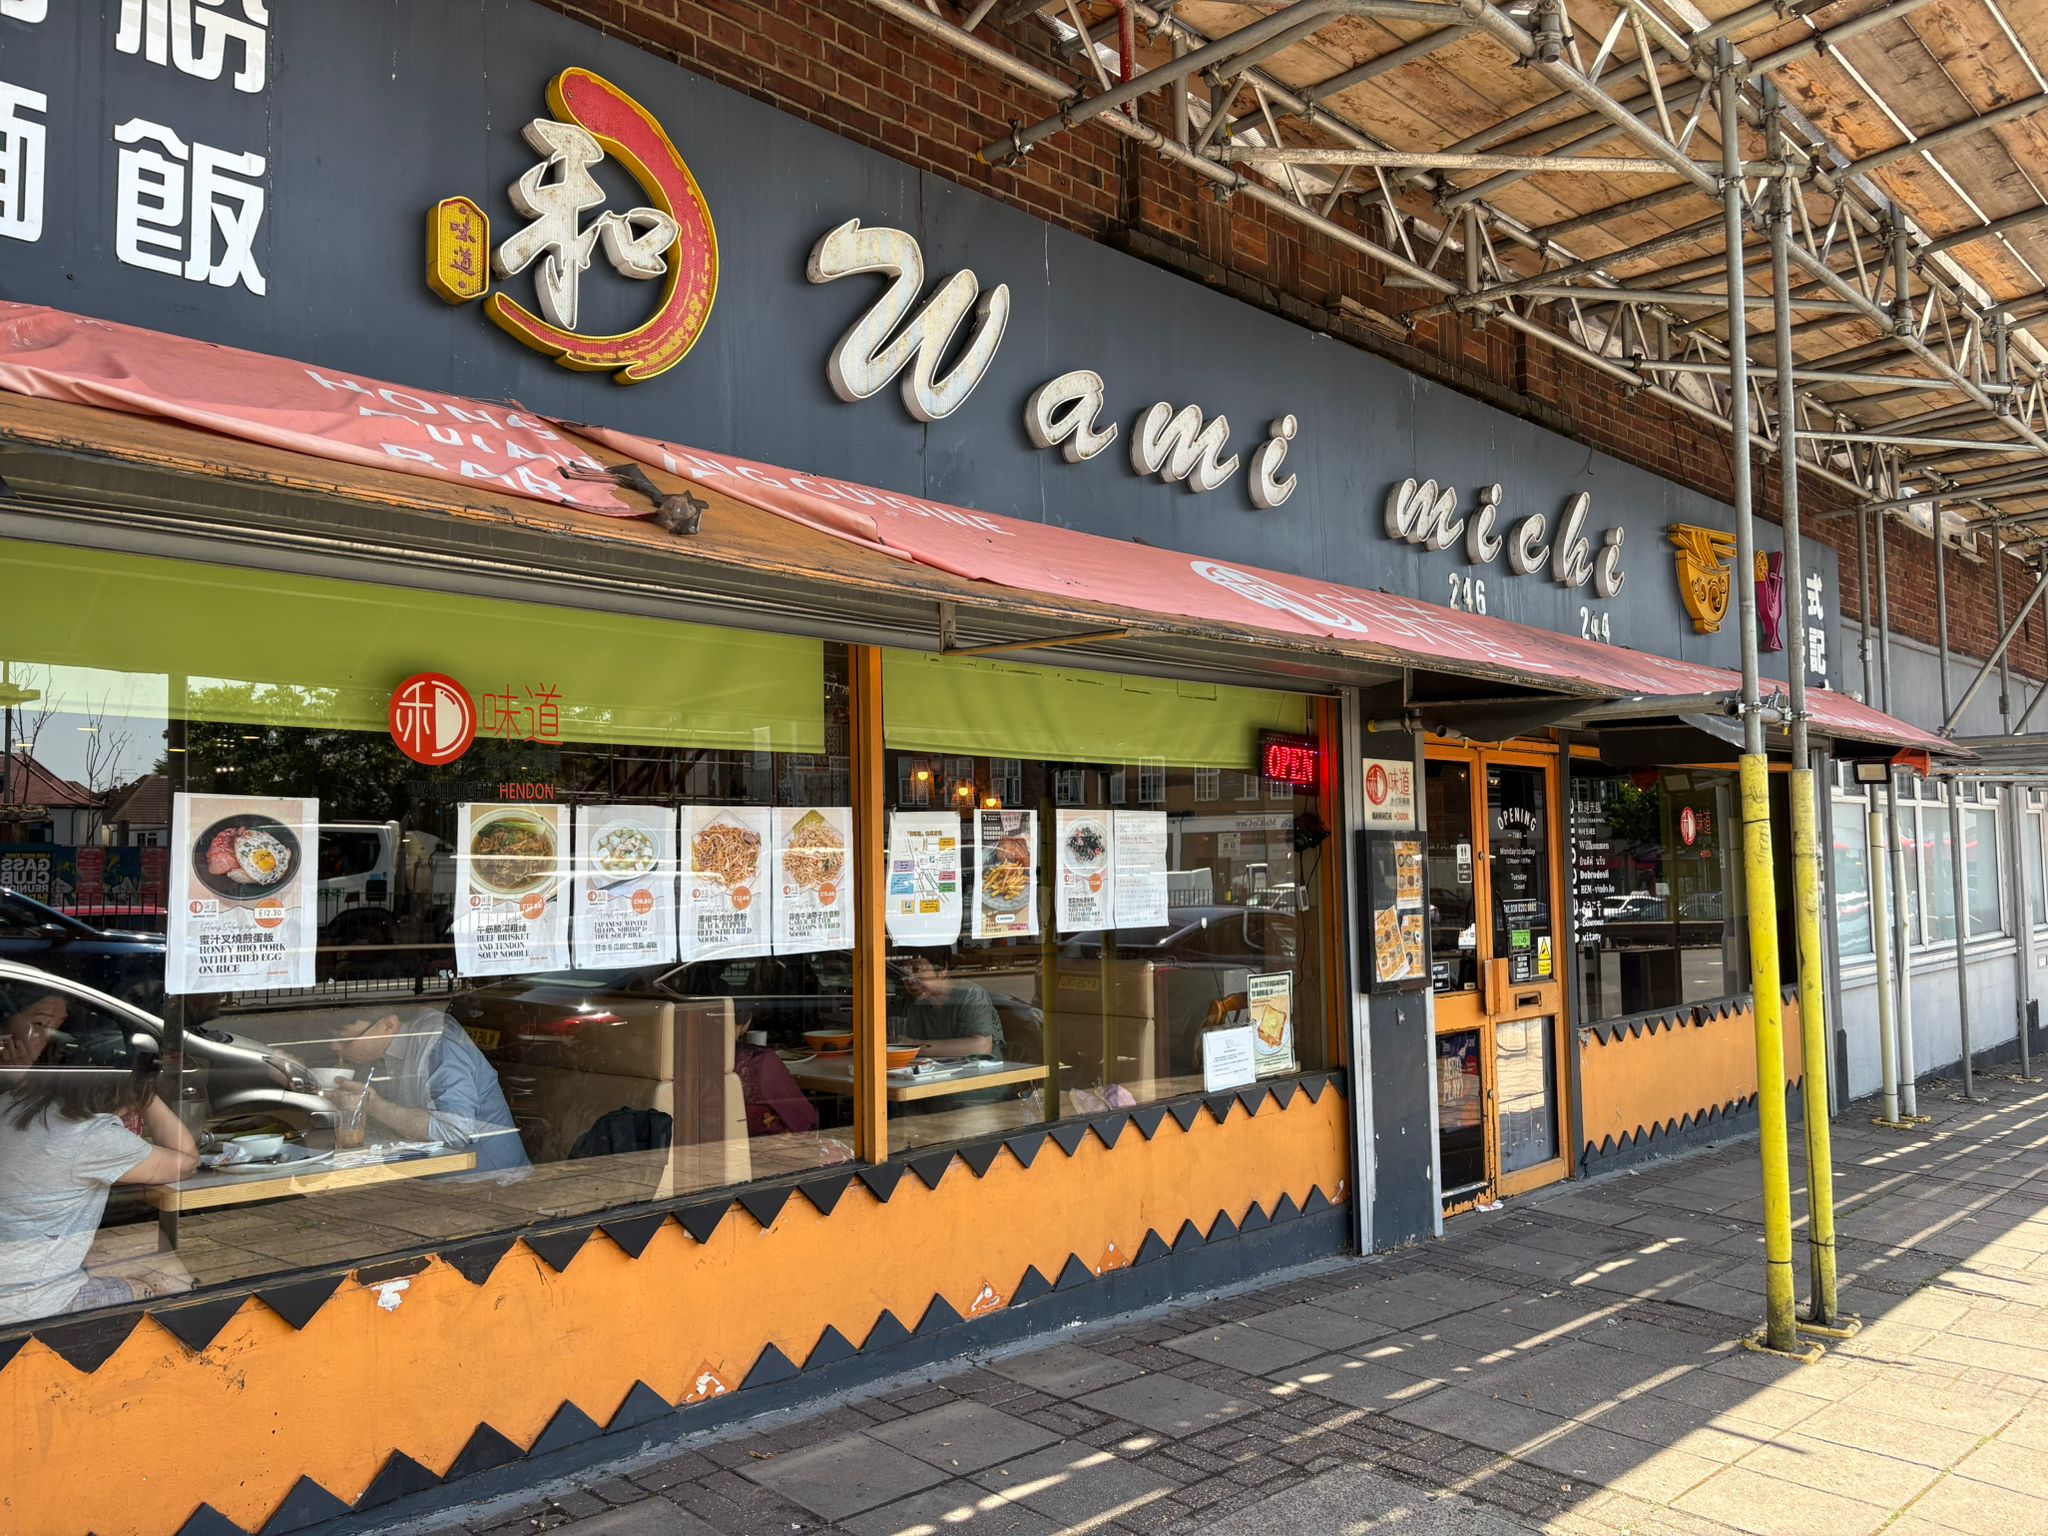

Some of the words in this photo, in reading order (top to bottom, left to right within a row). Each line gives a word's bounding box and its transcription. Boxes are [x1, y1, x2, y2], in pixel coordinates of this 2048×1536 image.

[114, 117, 267, 297] 飯
[806, 218, 1298, 510] Wami
[791, 477, 1015, 537] CUISINE
[1386, 477, 1626, 599] michi
[1448, 572, 1486, 616] 246
[1580, 606, 1611, 645] 244
[482, 681, 564, 746] 味道
[1268, 745, 1314, 782] OPEN
[500, 781, 556, 800] HENDON
[1388, 767, 1411, 795] 味道
[1497, 807, 1537, 832] OPENING
[1500, 847, 1516, 857] Monday
[1521, 847, 1536, 857] Sunday
[1510, 873, 1527, 882] Tuesday
[200, 946, 234, 955] HONEY
[259, 943, 286, 952] PORK
[495, 942, 525, 950] TENDON
[497, 933, 529, 941] BRISKET
[200, 955, 228, 964] WITH
[229, 953, 259, 963] FRIED
[261, 952, 282, 961] EGG
[478, 952, 498, 960] SOUP
[500, 950, 530, 958] NOODLE
[199, 965, 213, 974] ON
[215, 964, 240, 973] RICE
